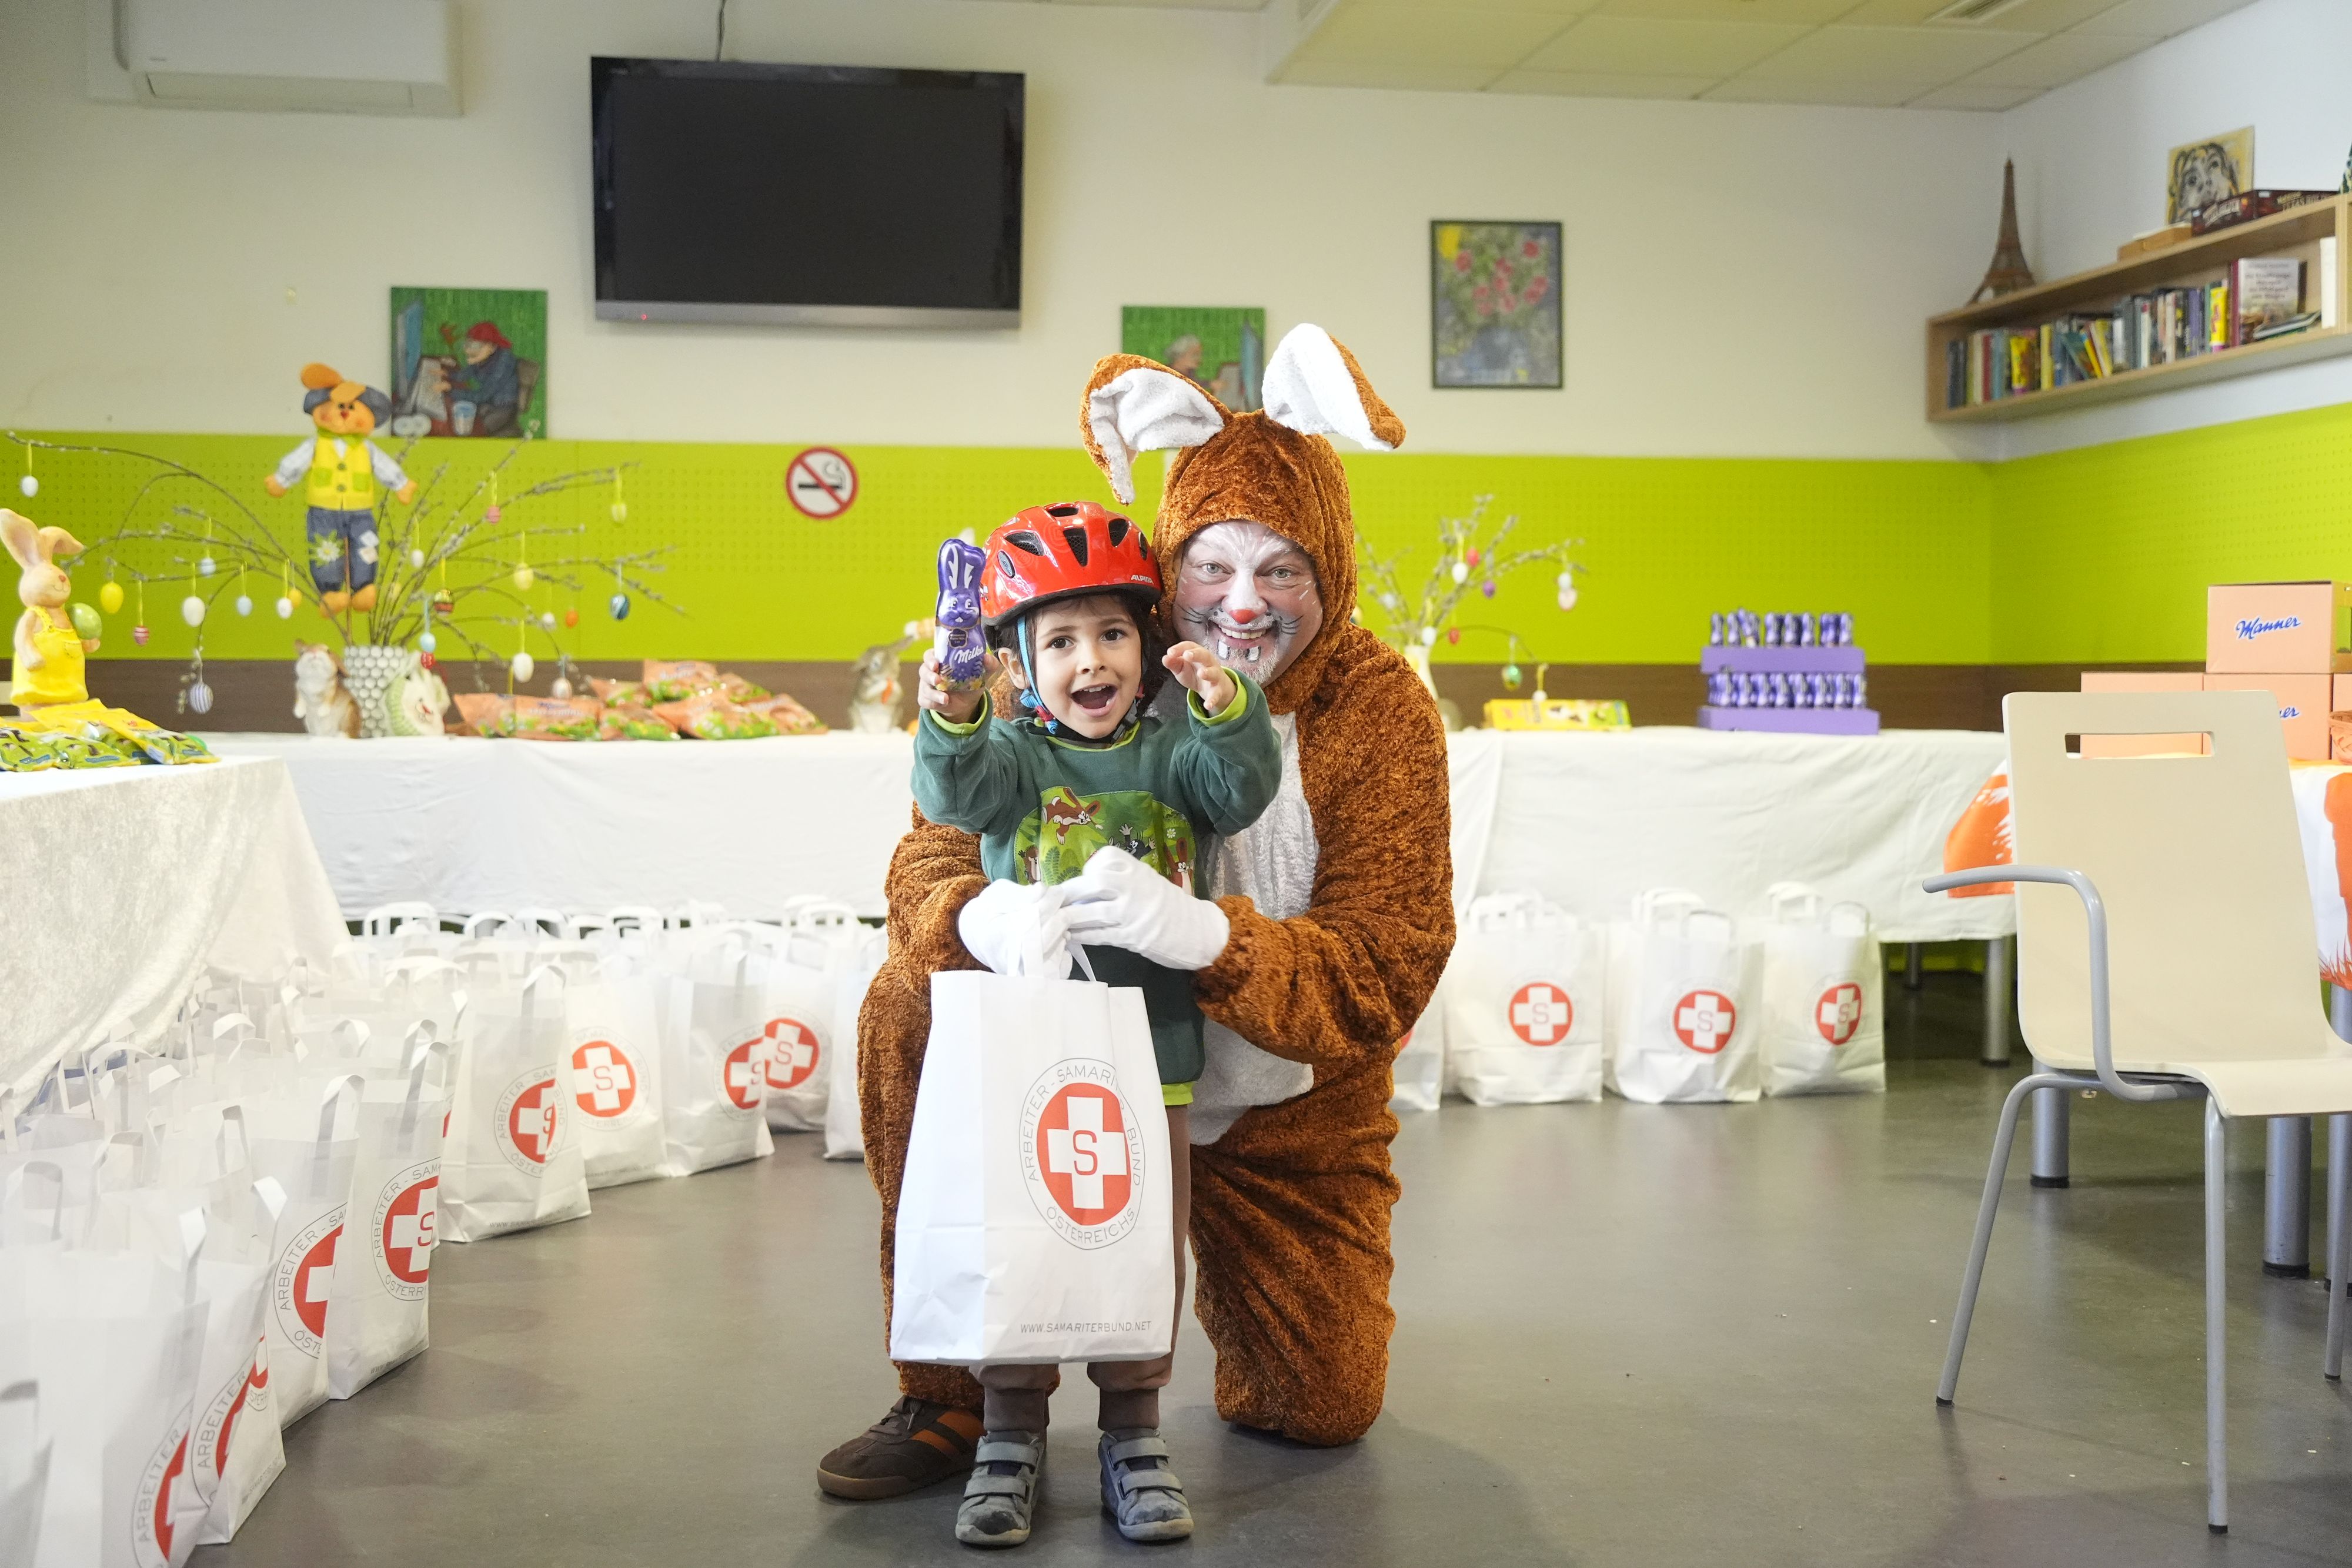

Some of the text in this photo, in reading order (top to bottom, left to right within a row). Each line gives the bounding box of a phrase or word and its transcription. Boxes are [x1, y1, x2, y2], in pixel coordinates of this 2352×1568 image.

[1130, 574, 1154, 584] ALPINA
[2236, 617, 2301, 640] Manner
[954, 645, 984, 664] Milka
[1531, 1001, 1551, 1025] S
[1696, 1009, 1713, 1033] S
[774, 1040, 794, 1066] S
[593, 1065, 614, 1091] S
[1023, 1084, 1050, 1182] ARBEITER
[1127, 1128, 1141, 1186] BUND
[1073, 1129, 1098, 1176] S
[373, 1182, 402, 1258] ARBEITER
[417, 1211, 435, 1247] S
[1046, 1205, 1135, 1244] ÖSTERREICHS
[278, 1229, 319, 1310] ARBEITER
[385, 1275, 426, 1296] ÖSTERR
[1020, 1320, 1152, 1334] WWW.SAMARITERBUND.NET
[197, 1370, 246, 1469] ARBEITER
